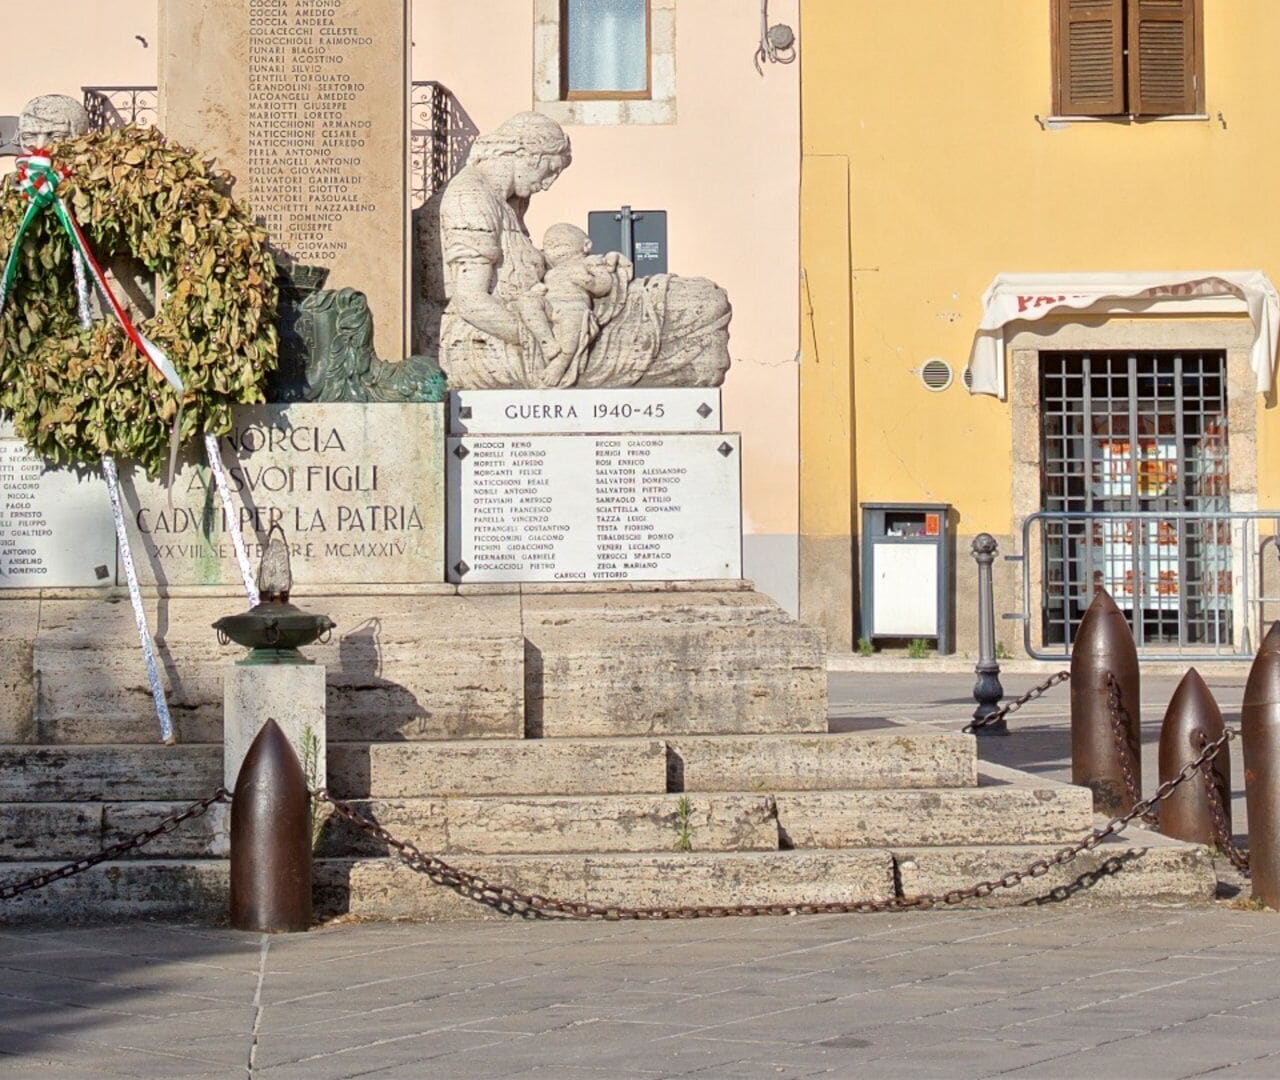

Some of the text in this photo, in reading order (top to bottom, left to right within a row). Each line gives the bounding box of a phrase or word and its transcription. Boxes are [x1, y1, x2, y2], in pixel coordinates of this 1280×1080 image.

[249, 0, 342, 8] COCCIA ANTONIO
[249, 8, 336, 17] COCCIA AMEDEO
[249, 18, 335, 27] COCCIA ANDREA
[319, 27, 359, 36] CELESTE
[319, 37, 373, 46] RAIMONDO
[248, 46, 326, 55] FUNARI BIAGIO
[248, 55, 344, 64] FUNARI AGOSTINO
[248, 64, 285, 73] FUNARI
[248, 74, 287, 83] GENTILI
[318, 83, 365, 92] SERTORIO
[316, 92, 357, 101] AMEDEO
[248, 102, 348, 111] MARIOTTI GIUSEPPE
[248, 111, 343, 120] MARIOTTI LORETO
[248, 120, 372, 129] NATICCHIONI ARMANDO
[248, 130, 357, 139] NATICCHIONI CESARE
[248, 139, 365, 148] NATICCHIONI ALFREDO
[248, 148, 331, 157] PERLA ANTONIO
[248, 157, 361, 166] PETRANGELI ANTONIO
[248, 166, 341, 175] POLICA GIOVANNI
[308, 176, 362, 185] GARIBALDI
[308, 185, 348, 194] GIOTTO
[308, 194, 359, 203] PASQUALE
[314, 204, 376, 213] NAZZARENO
[289, 213, 343, 223] DOMENICO
[289, 222, 333, 232] GIUSEPPE
[297, 240, 348, 250] GIOVANNI
[505, 403, 665, 419] GUERRA 1940-45
[220, 426, 346, 453] NORCIA
[229, 466, 295, 492] SVOI
[307, 465, 379, 492] FIGLI
[239, 506, 284, 533] PER
[295, 506, 327, 532] LA
[337, 505, 424, 532] PATRIA
[324, 542, 407, 558] MCMXXIV
